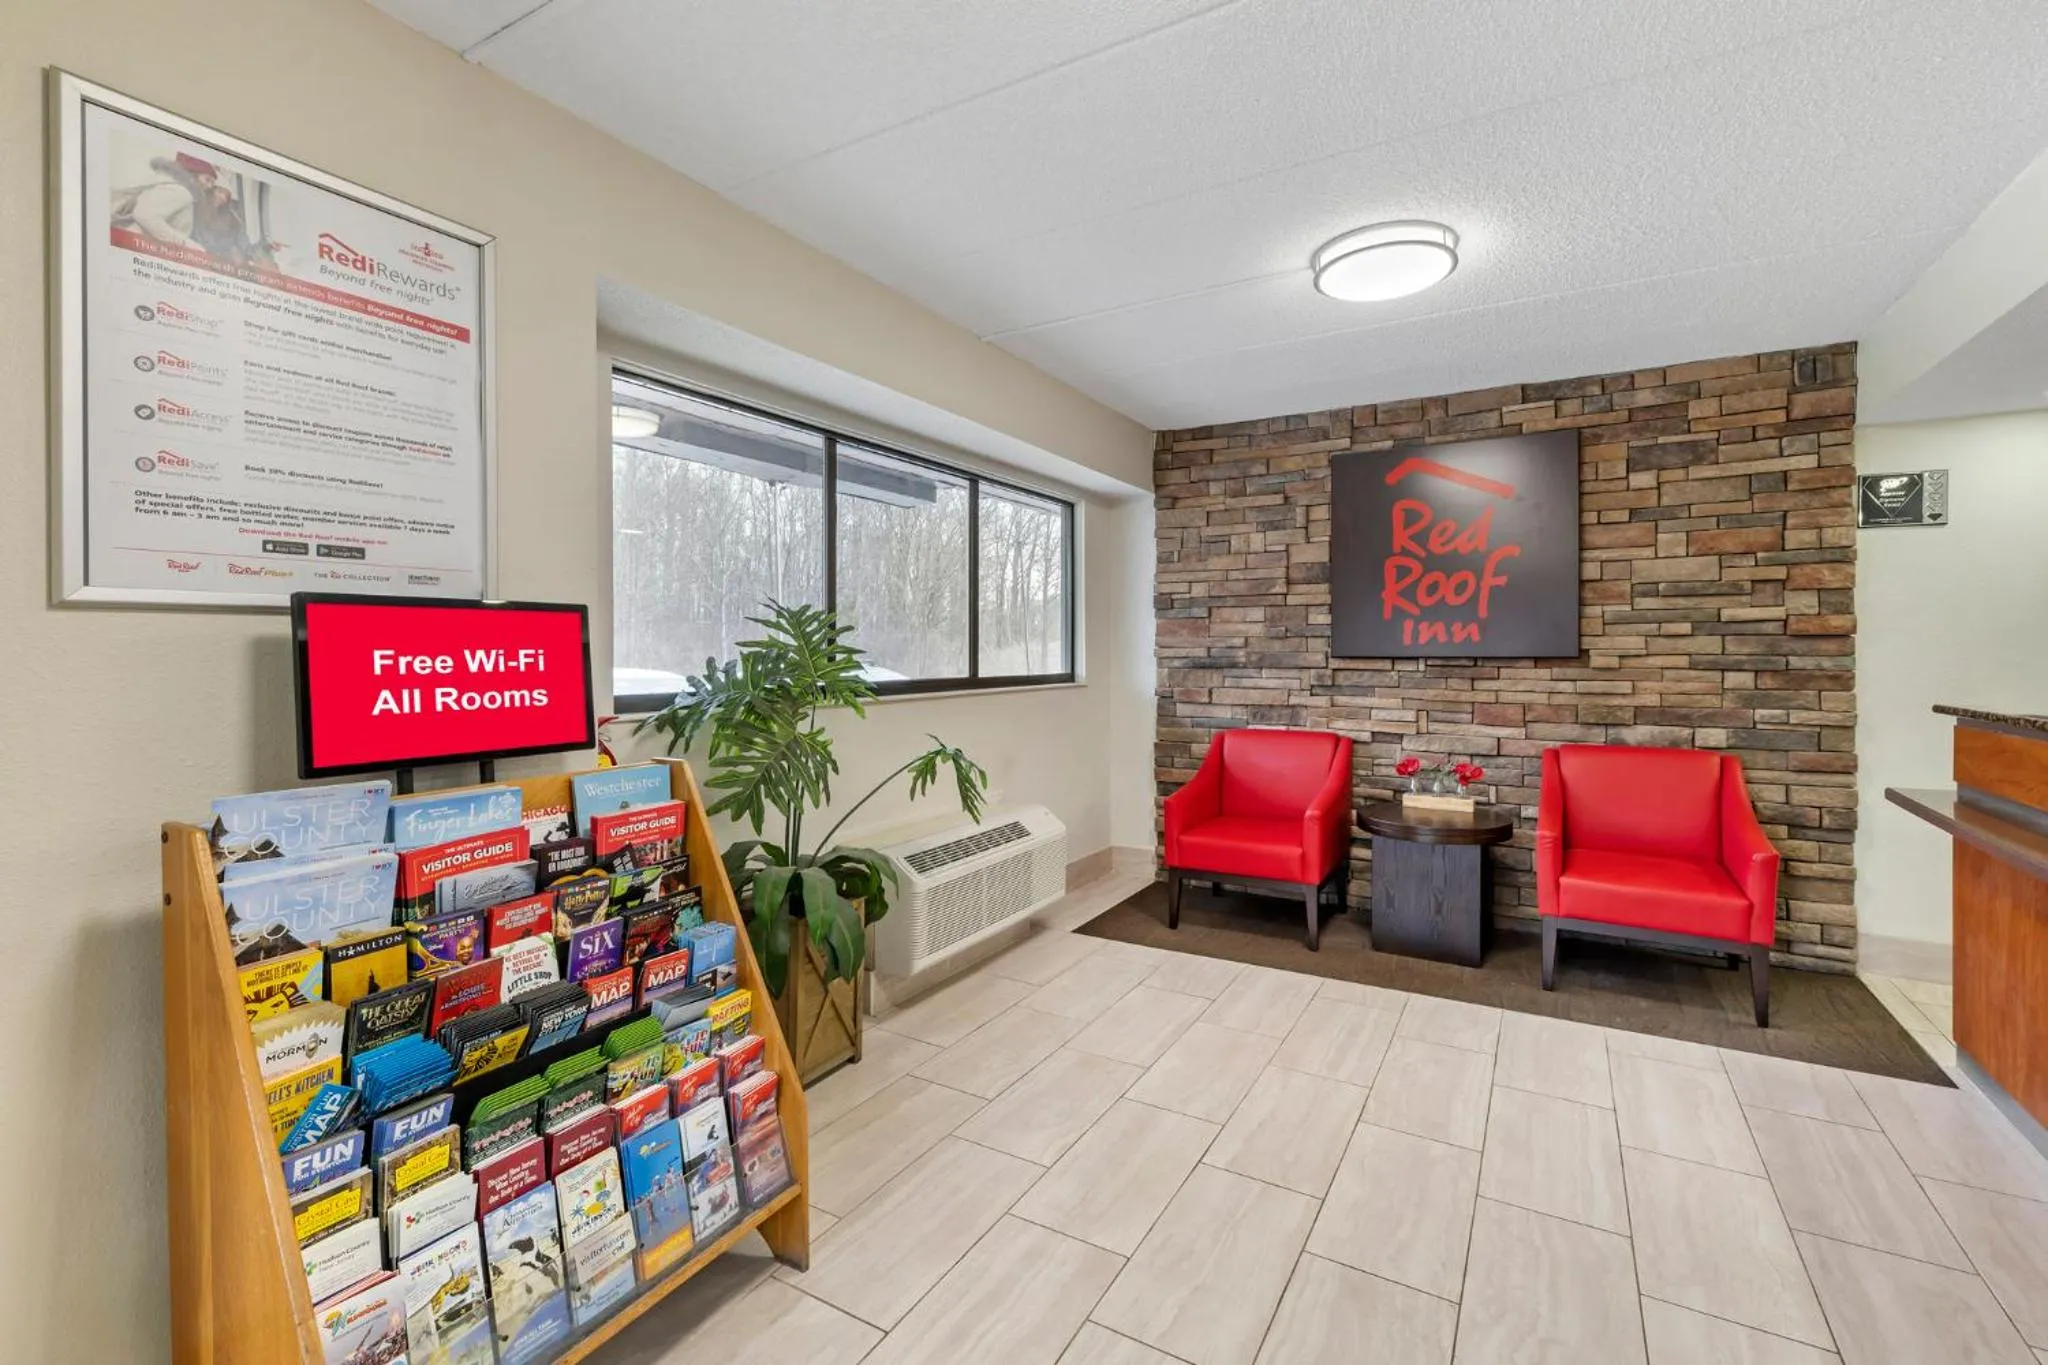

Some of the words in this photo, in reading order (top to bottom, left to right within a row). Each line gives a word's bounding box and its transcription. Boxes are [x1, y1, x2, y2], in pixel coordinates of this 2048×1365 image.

[202, 274, 230, 289] offers
[339, 309, 364, 325] brand
[320, 264, 366, 287] Beyond
[370, 279, 393, 295] free
[396, 289, 431, 307] nights
[133, 267, 152, 280] the
[154, 273, 195, 291] industry
[198, 284, 217, 296] and
[243, 296, 281, 313] Beyond
[283, 305, 302, 317] free
[305, 311, 335, 327] nights
[388, 333, 399, 343] for
[368, 303, 404, 323] Beyond
[406, 314, 426, 328] free
[267, 325, 279, 334] for
[303, 427, 317, 437] and
[134, 490, 163, 499] Other
[165, 492, 204, 503] benefits
[206, 497, 242, 507] include:
[283, 506, 320, 516] discounts
[323, 510, 337, 518] and
[134, 498, 146, 506] of
[148, 499, 184, 510] special
[185, 503, 217, 513] offers,
[219, 506, 239, 515] free
[239, 508, 273, 519] bottled
[302, 515, 336, 525] member
[134, 506, 161, 516] from
[171, 510, 188, 518] am
[205, 513, 220, 521] am
[222, 515, 240, 523] and
[253, 517, 278, 527] much
[238, 527, 282, 538] Download
[1391, 498, 1495, 558] Red
[314, 571, 328, 579] THE
[343, 573, 391, 583] COLLECTION
[1381, 545, 1521, 620] Roof
[372, 649, 454, 676] Free
[464, 648, 546, 674] Wi-Fi
[371, 689, 421, 716] All
[435, 687, 549, 713] Rooms
[584, 776, 662, 798] Westchester
[233, 799, 372, 835] ULSTER
[405, 808, 461, 846] Finger
[468, 793, 514, 827] Lakes
[610, 823, 648, 838] VISITOR
[649, 815, 677, 829] GUIDE
[221, 819, 377, 859] COUNTY
[421, 853, 471, 875] VISITOR
[473, 842, 514, 861] GUIDE
[245, 875, 381, 921] ULSTER
[233, 894, 384, 947] COUNTY
[507, 972, 533, 994] LITTLE
[648, 965, 686, 987] MAP
[591, 982, 630, 1009] MAP
[711, 995, 750, 1024] RAFTING
[361, 1005, 384, 1021] THE
[565, 1004, 588, 1020] YORK
[265, 1033, 328, 1064] MORMON
[294, 1093, 342, 1150] MAP
[394, 1103, 446, 1143] FUN
[292, 1139, 355, 1182] FUN
[346, 1239, 371, 1255] County
